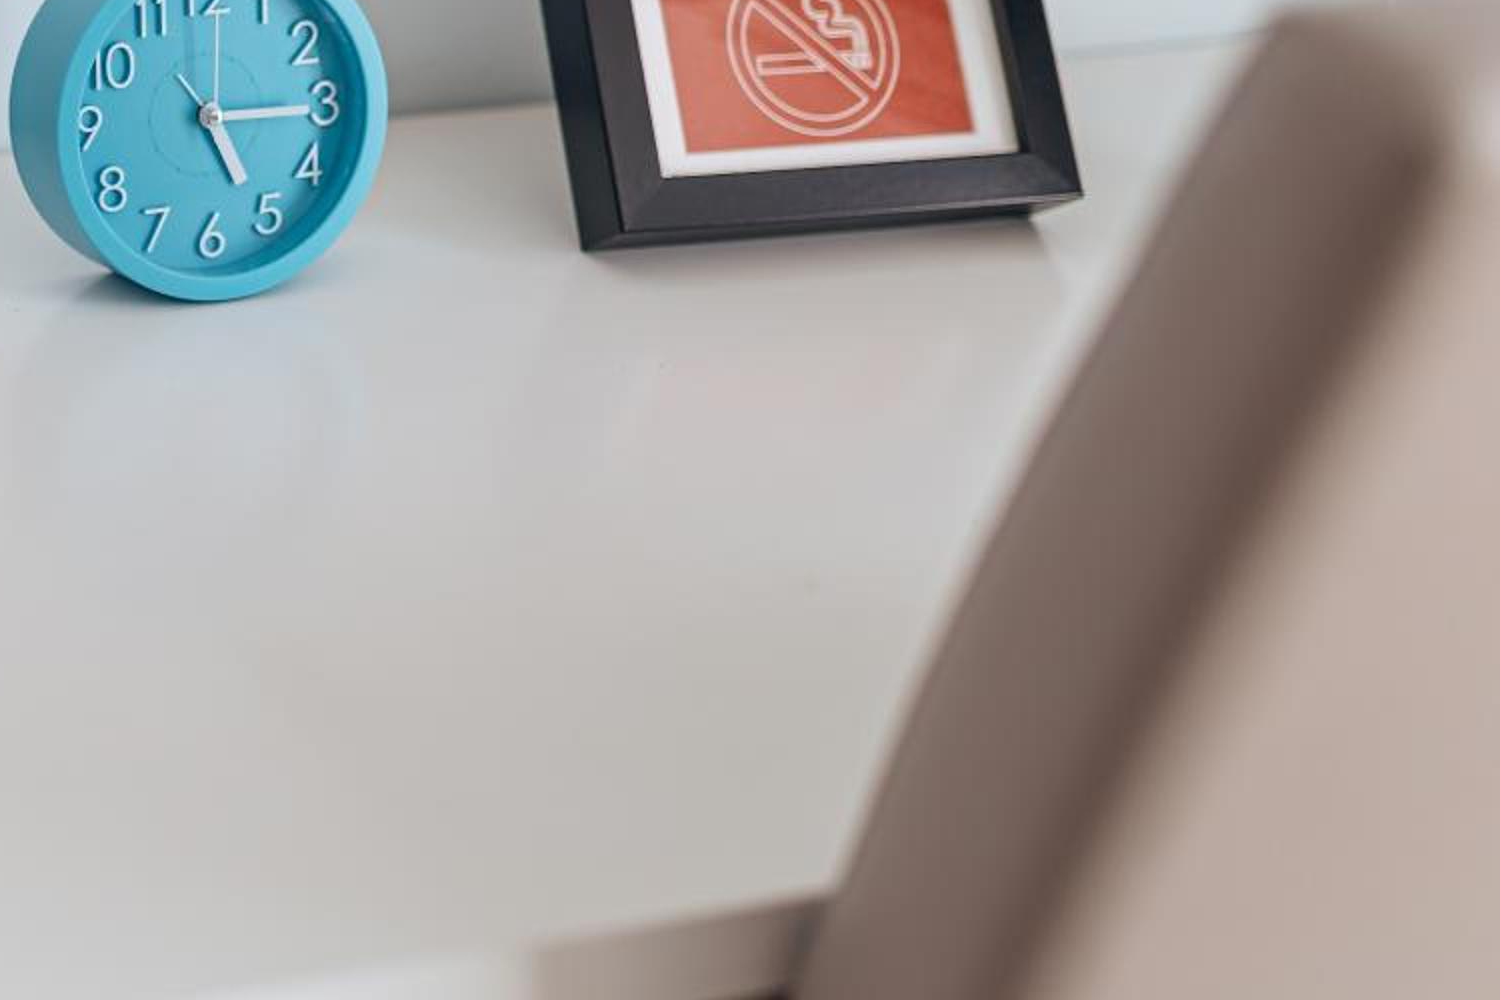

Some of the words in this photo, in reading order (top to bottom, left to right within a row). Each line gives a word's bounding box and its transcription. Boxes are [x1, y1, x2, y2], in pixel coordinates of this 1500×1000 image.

[90, 41, 136, 91] 10
[290, 20, 321, 67] 2
[308, 80, 340, 127] 3
[78, 105, 102, 153] 9
[294, 141, 323, 186] 4
[98, 165, 128, 213] 8
[143, 206, 172, 253] 7
[198, 212, 226, 259] 6
[252, 192, 283, 235] 5
